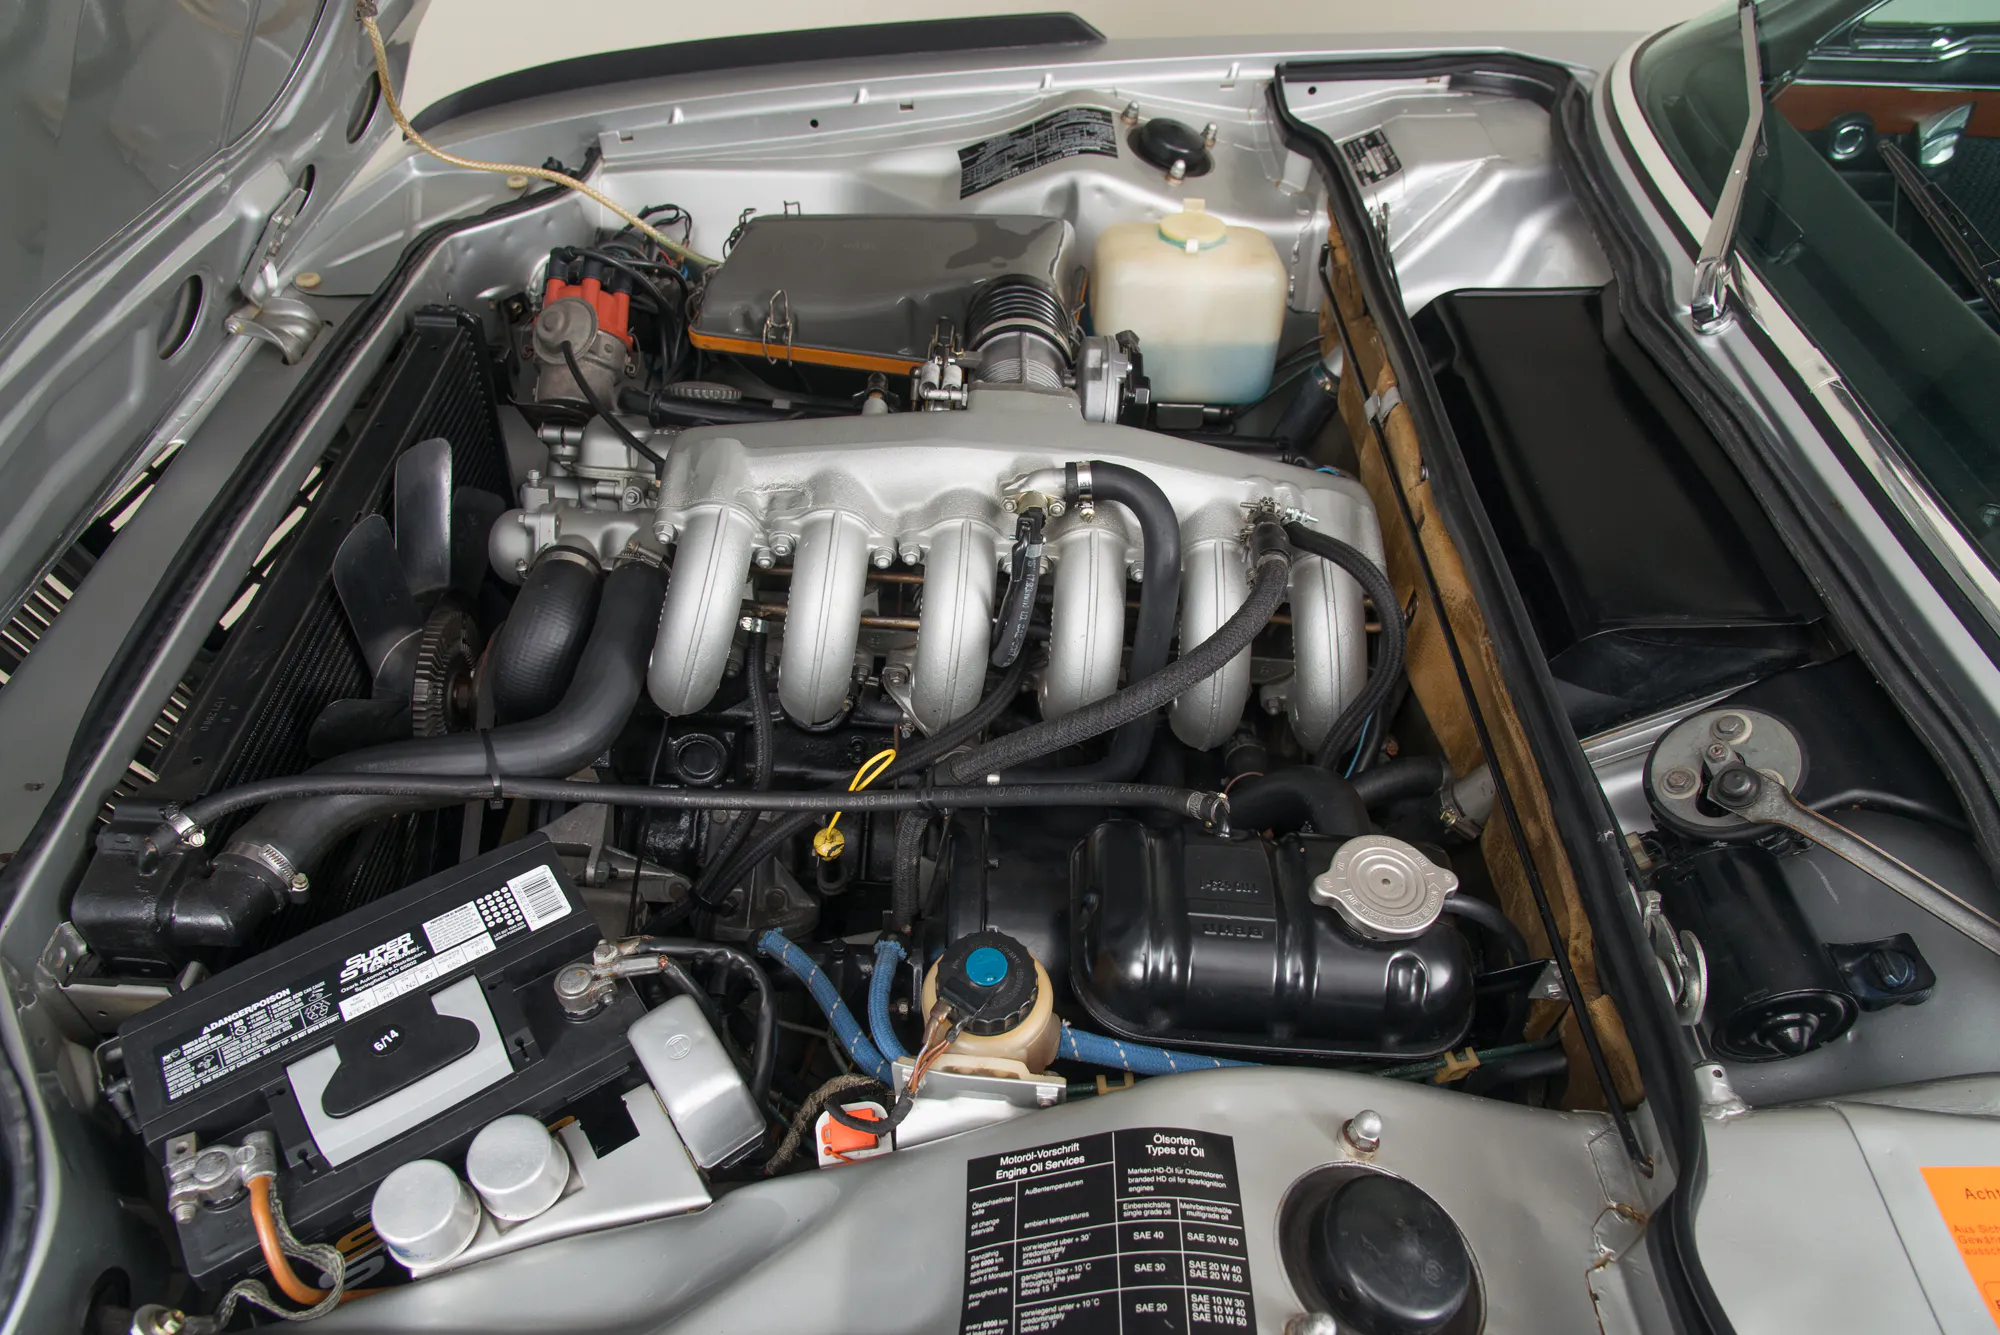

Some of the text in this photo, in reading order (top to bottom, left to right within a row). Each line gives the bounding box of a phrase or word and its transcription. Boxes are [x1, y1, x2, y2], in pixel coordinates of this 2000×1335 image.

[881, 795, 909, 806] BMW
[345, 932, 411, 972] SUPER
[475, 945, 488, 956] 810
[340, 940, 414, 984] START
[359, 964, 392, 985] Automotive
[392, 947, 426, 969] Distributors
[388, 967, 399, 976] MO
[424, 971, 433, 980] 47
[210, 988, 291, 1030] DANGER/POISON
[233, 1018, 244, 1027] NO
[374, 1030, 399, 1051] 6/14
[211, 1067, 229, 1079] REACH
[306, 1024, 319, 1034] OPEN
[1154, 1133, 1195, 1146] Ölsorten
[1000, 1143, 1079, 1166] Motoröl-Vorschrift
[1146, 1145, 1204, 1157] Types of Oil
[996, 1155, 1085, 1180] Engine Oil Services
[1128, 1166, 1173, 1174] Marken-HD-Öl
[1185, 1168, 1223, 1179] Ottomotoren
[1025, 1179, 1083, 1196] Außentemperaturen
[1129, 1185, 1154, 1193] engines
[1188, 1178, 1226, 1188] sparkignition
[972, 1208, 984, 1216] valle
[1123, 1202, 1170, 1210] Einbereichsöle
[1024, 1211, 1089, 1229] ambient temperatures
[1186, 1209, 1219, 1220] multigrade
[979, 1218, 1000, 1228] change
[971, 1226, 994, 1236] intervals
[1133, 1231, 1164, 1240] SAE 40
[1187, 1232, 1238, 1246] SAE 20 W 50
[1022, 1240, 1058, 1252] vorwiegend
[1054, 1267, 1069, 1276] über
[1135, 1263, 1165, 1273] SAE 30
[1189, 1260, 1241, 1274] SAE 20 W 40
[1021, 1278, 1054, 1288] throughout
[1067, 1273, 1081, 1282] year
[1190, 1269, 1242, 1283] SAE 20 W 50
[968, 1300, 980, 1310] year
[1191, 1294, 1244, 1308] SAE 10 W 30
[1021, 1306, 1057, 1318] vorwiegend
[1058, 1303, 1074, 1311] unter
[1136, 1303, 1167, 1313] SAE 20
[1192, 1303, 1246, 1317] SAE 10 W 40
[1192, 1312, 1247, 1326] SAE 10 W 50
[966, 1322, 982, 1331] every
[983, 1320, 998, 1328] 6000
[1021, 1324, 1040, 1333] below
